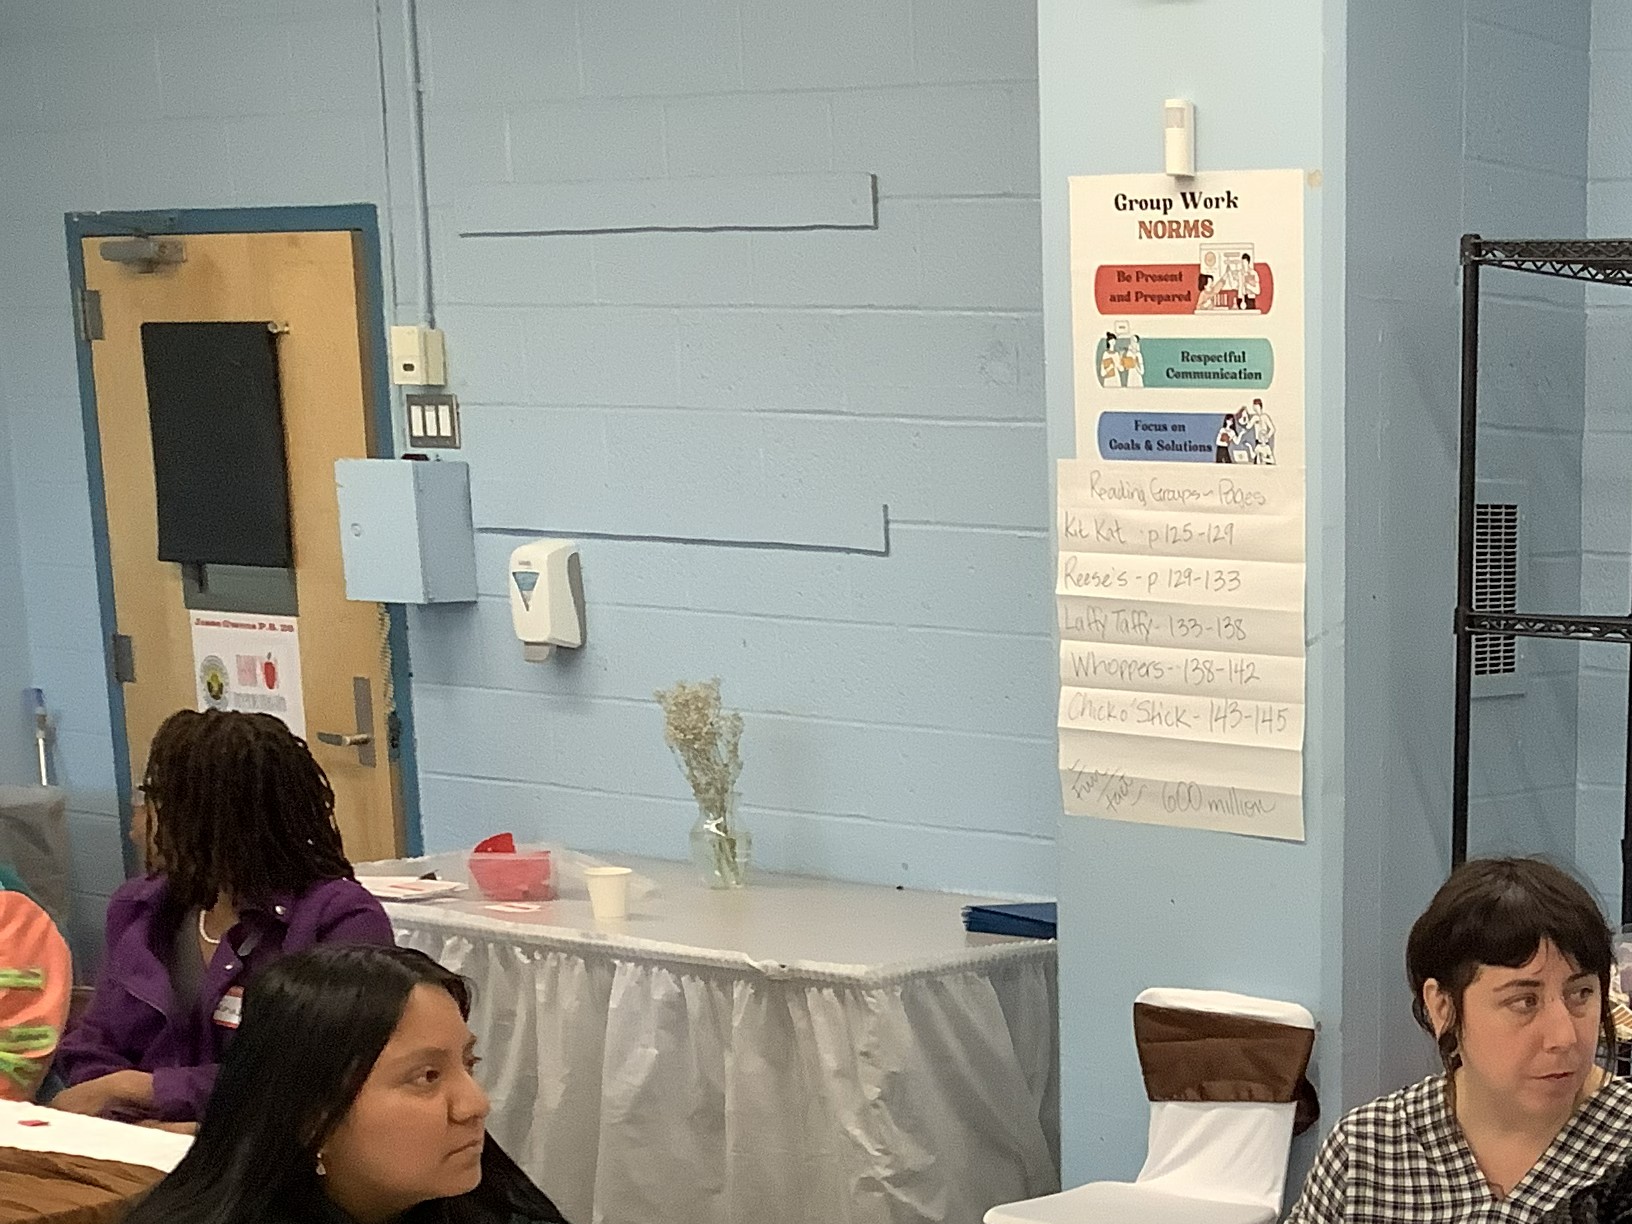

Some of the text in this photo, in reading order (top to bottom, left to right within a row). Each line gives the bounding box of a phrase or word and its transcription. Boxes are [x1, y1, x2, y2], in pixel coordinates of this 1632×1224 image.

[1114, 190, 1239, 215] Group Work
[1138, 219, 1214, 240] NORMS
[1117, 271, 1183, 283] Be Present
[1109, 291, 1192, 305] and Prepared
[1180, 350, 1246, 366] Respectful
[1166, 367, 1262, 380] Communication
[1134, 419, 1186, 431] Focus on
[1109, 438, 1213, 452] Goals & Solutions
[1090, 470, 1146, 506] Reading
[1218, 478, 1266, 508] Pages
[1065, 511, 1088, 539] Kit
[1095, 519, 1126, 544] Kat
[1064, 555, 1128, 589] Reese's
[1168, 567, 1241, 591] 129-133
[1064, 606, 1107, 638] Laffy
[1169, 615, 1247, 641] 133-138
[1210, 699, 1289, 735] 143-145
[1208, 787, 1276, 818] million
